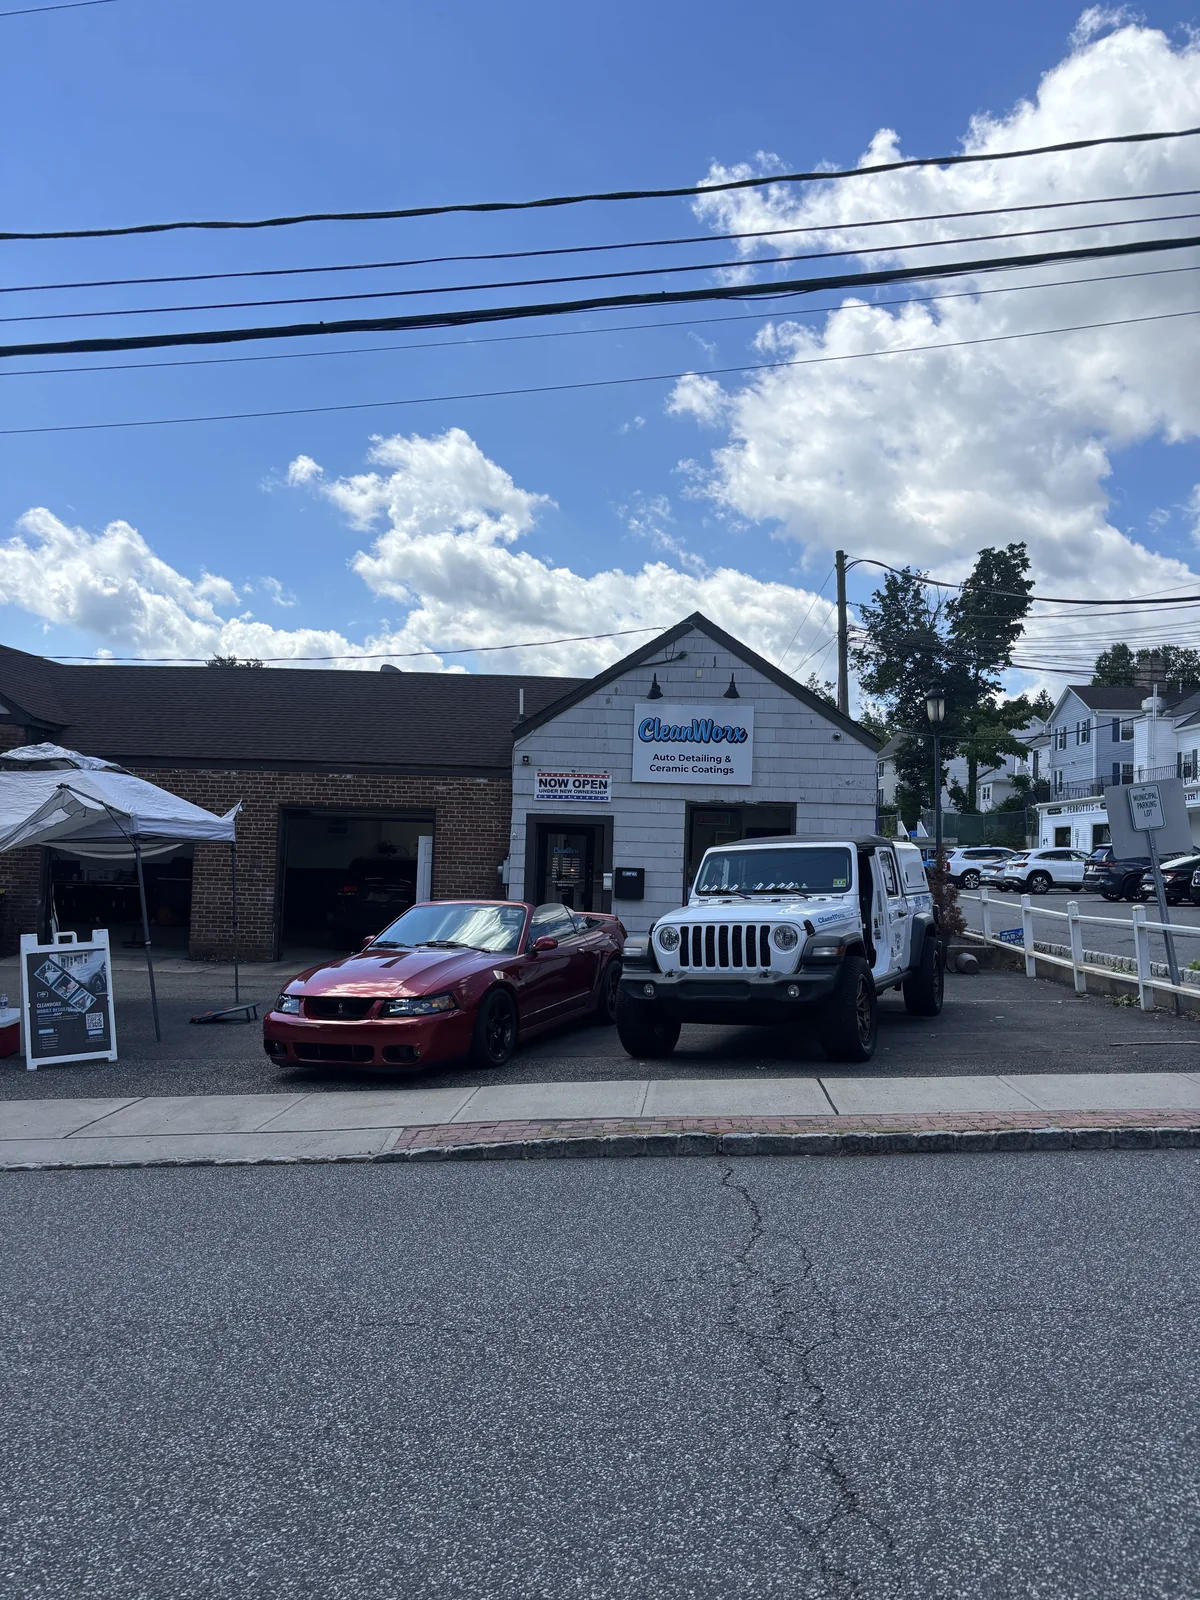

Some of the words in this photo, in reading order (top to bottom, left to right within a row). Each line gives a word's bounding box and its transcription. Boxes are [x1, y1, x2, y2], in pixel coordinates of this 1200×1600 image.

[638, 717, 748, 743] CleanWorx
[653, 753, 676, 762] Auto
[678, 754, 722, 764] Detailing
[724, 755, 732, 763] &
[650, 764, 689, 773] Ceramic
[691, 765, 735, 775] Coatings
[538, 778, 568, 789] NOW
[572, 779, 608, 790] OPEN
[1133, 791, 1158, 801] MUNICIPAL
[1136, 800, 1157, 809] PARKING
[1143, 809, 1153, 817] LOT
